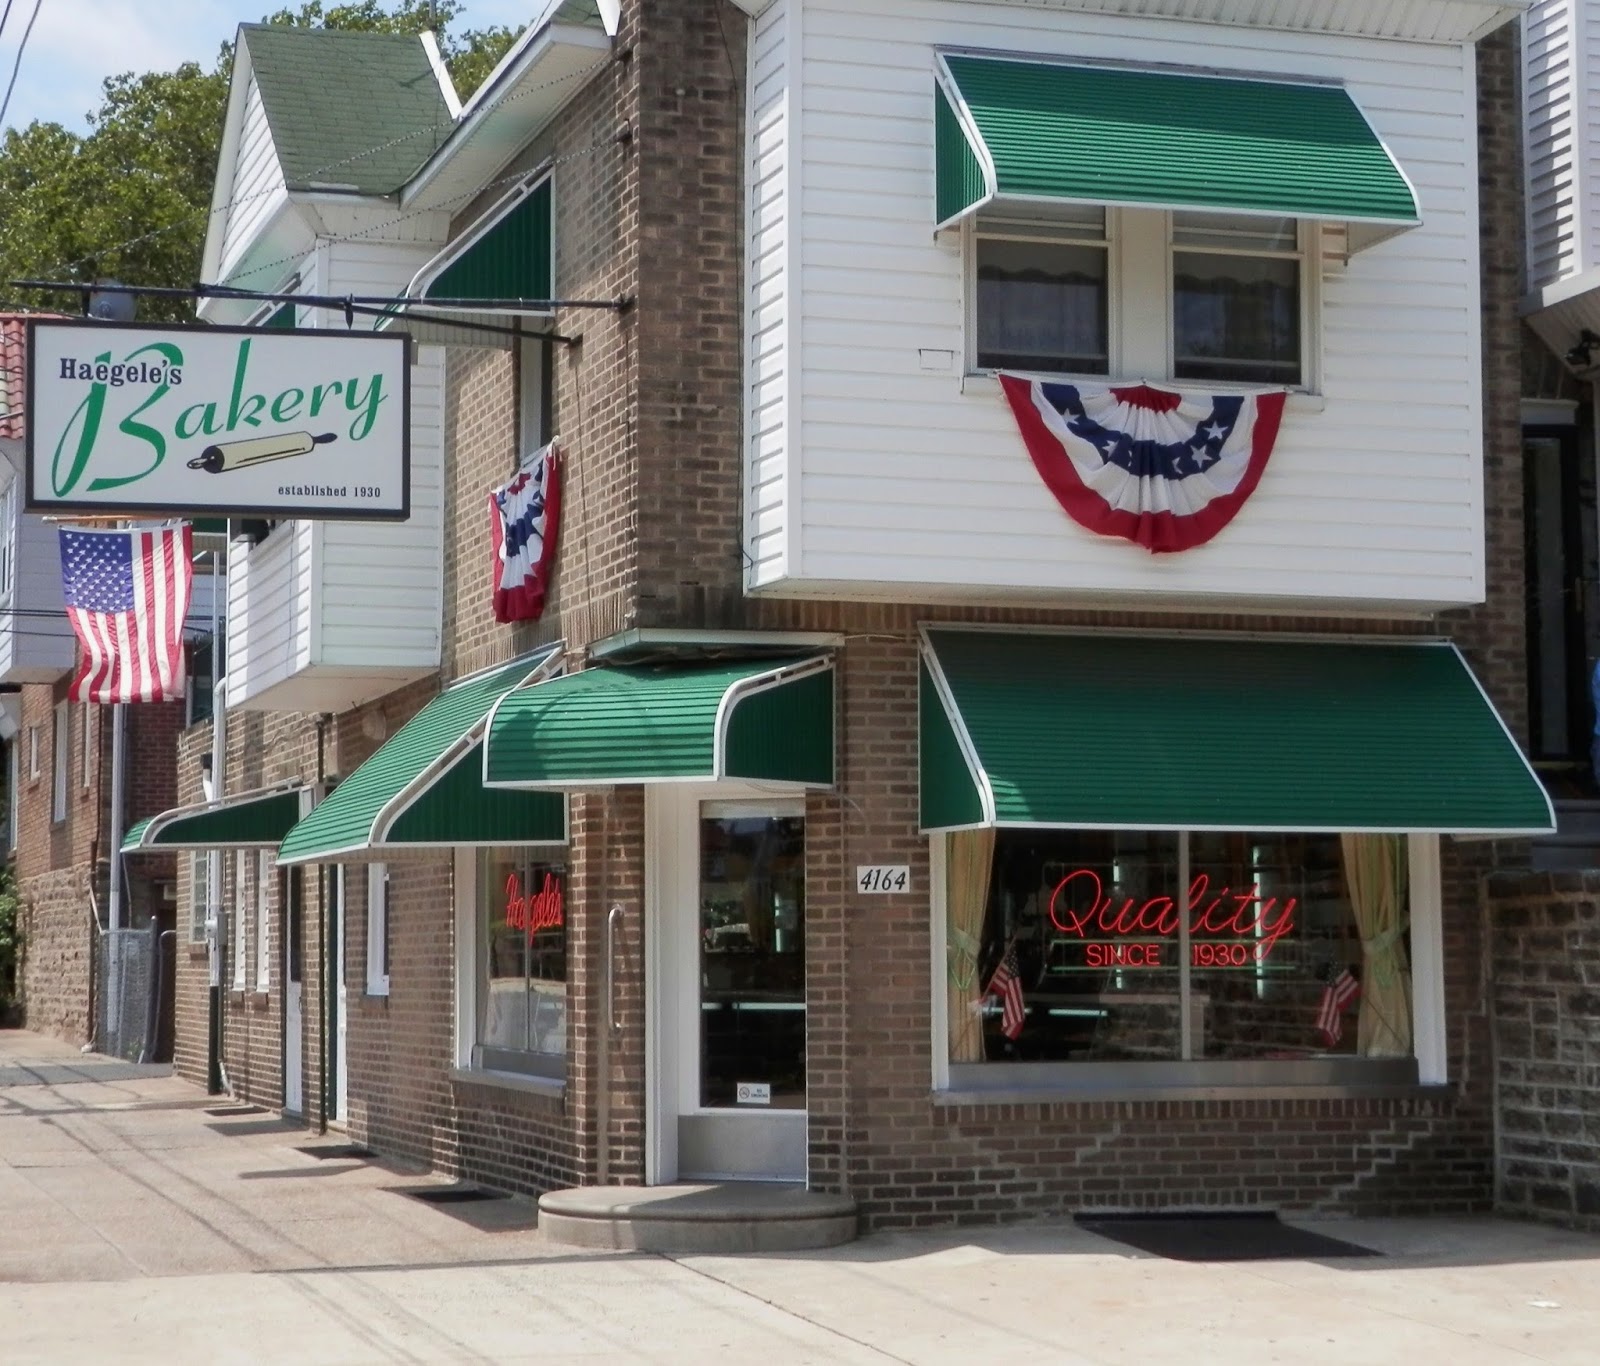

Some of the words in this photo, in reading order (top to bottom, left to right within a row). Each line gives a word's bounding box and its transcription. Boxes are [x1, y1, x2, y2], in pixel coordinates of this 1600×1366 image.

[59, 357, 182, 387] Haegele's
[51, 338, 388, 497] Bakery
[278, 484, 347, 497] established
[354, 486, 381, 498] 1930
[860, 868, 906, 891] 4164
[1050, 869, 1297, 960] Quality
[1086, 944, 1160, 966] SINCE
[1193, 944, 1247, 966] 1930
